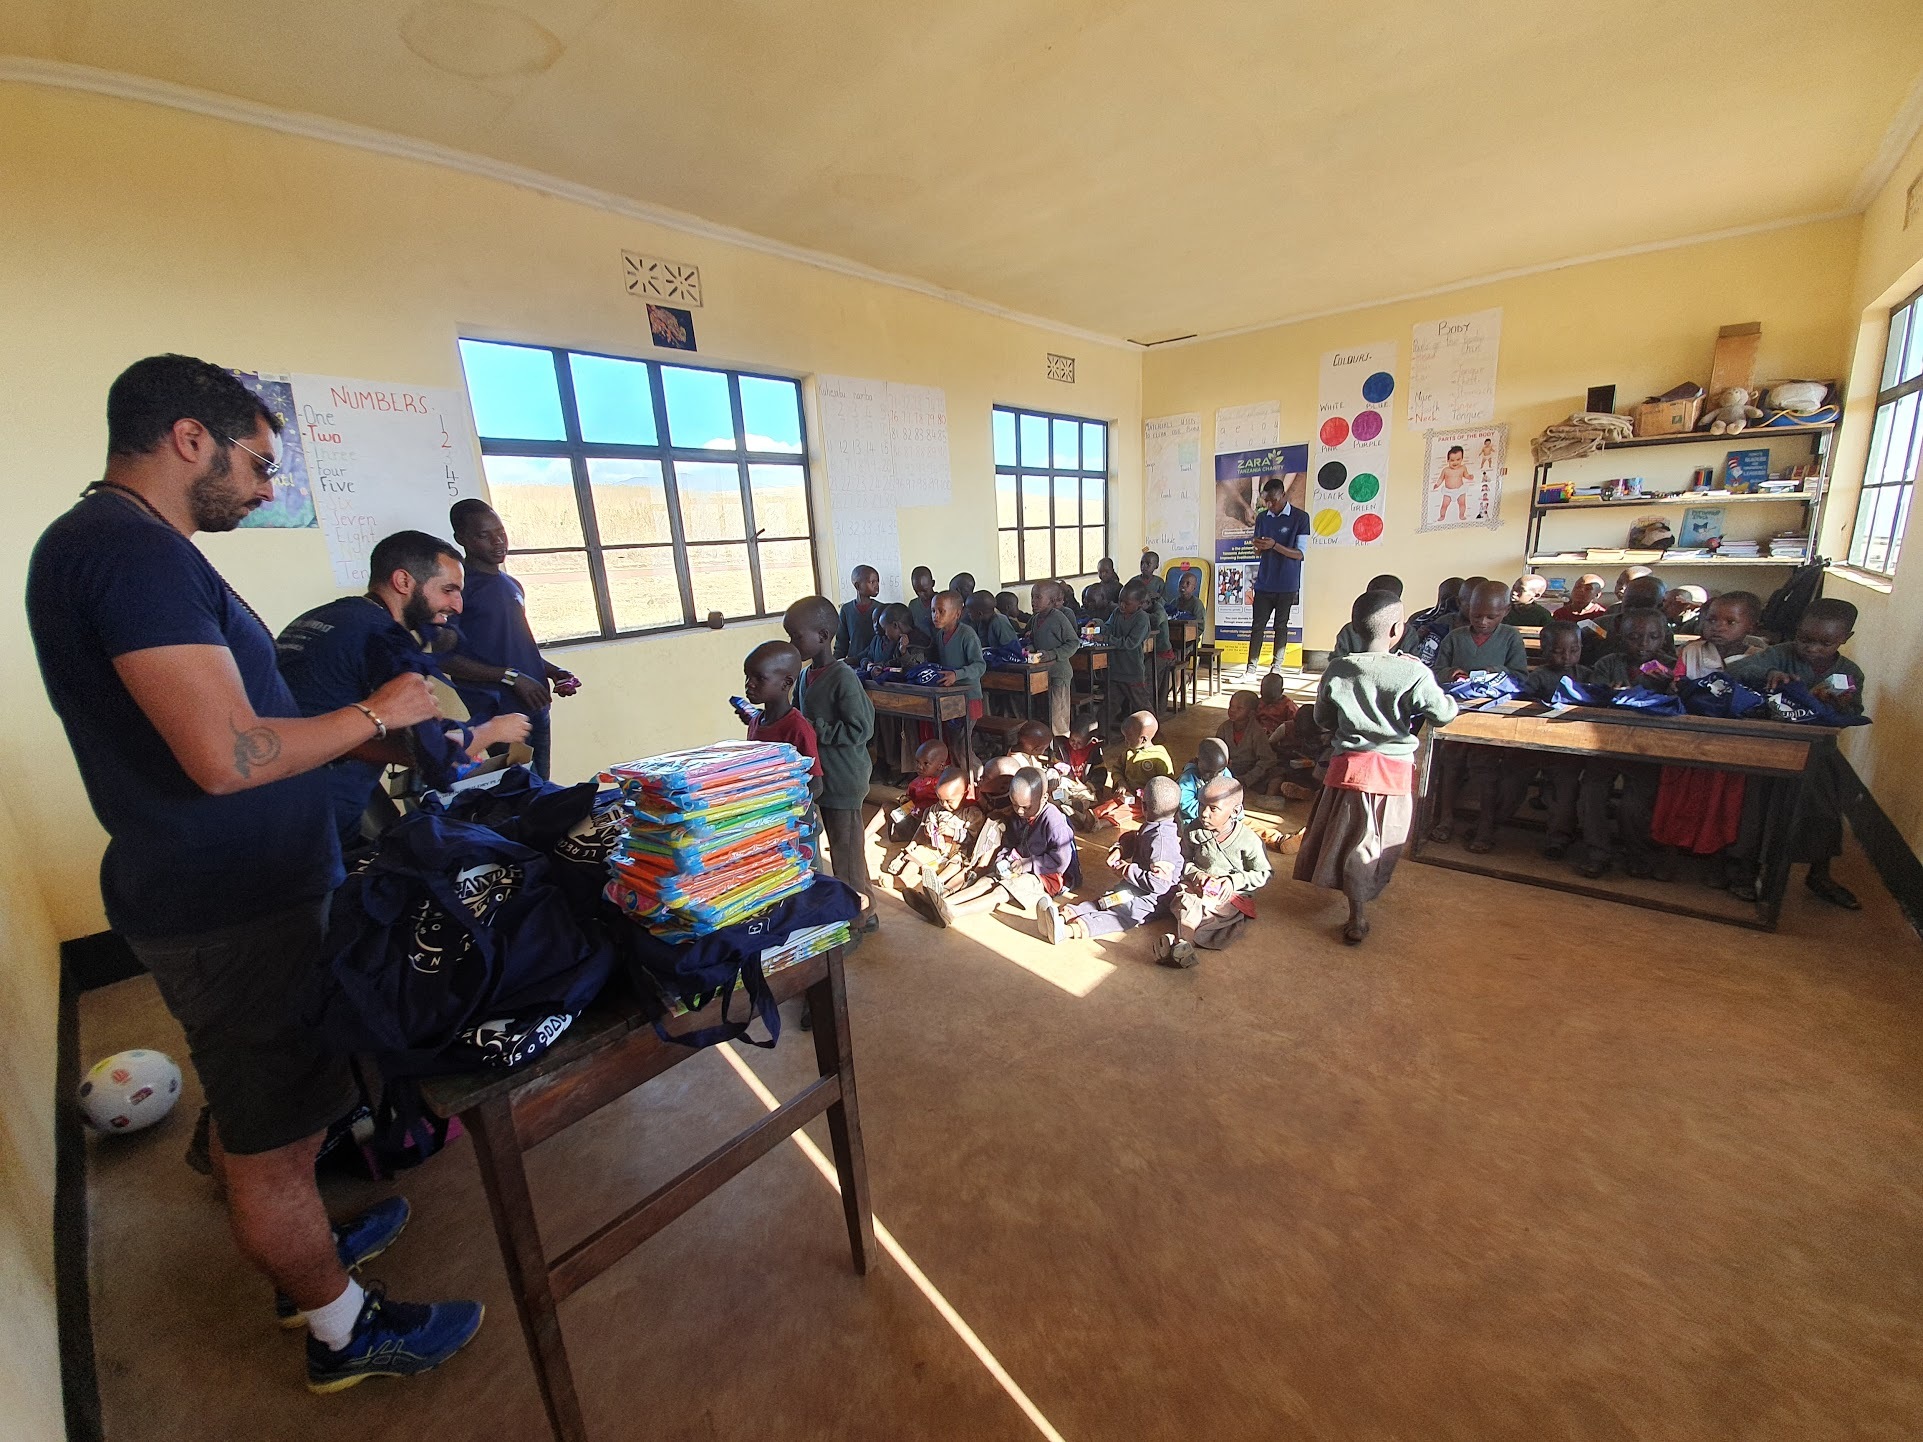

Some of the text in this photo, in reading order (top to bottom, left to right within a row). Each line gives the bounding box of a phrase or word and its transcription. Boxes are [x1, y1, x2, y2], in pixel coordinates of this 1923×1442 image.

[1320, 402, 1345, 412] WHITE
[441, 431, 452, 448] 2
[902, 428, 912, 441] 82
[914, 427, 924, 441] 83
[926, 428, 936, 441] 84
[839, 440, 848, 454] 12
[852, 440, 861, 455] 13
[866, 441, 875, 453] 14
[1237, 456, 1271, 469] ZARA
[445, 464, 459, 482] 4
[1236, 467, 1262, 475] TANZANIA
[320, 476, 356, 493] Five
[447, 481, 459, 497] 5
[1313, 488, 1344, 500] BLACK
[1350, 503, 1376, 511] GREEN
[1312, 536, 1339, 545] YELLOW
